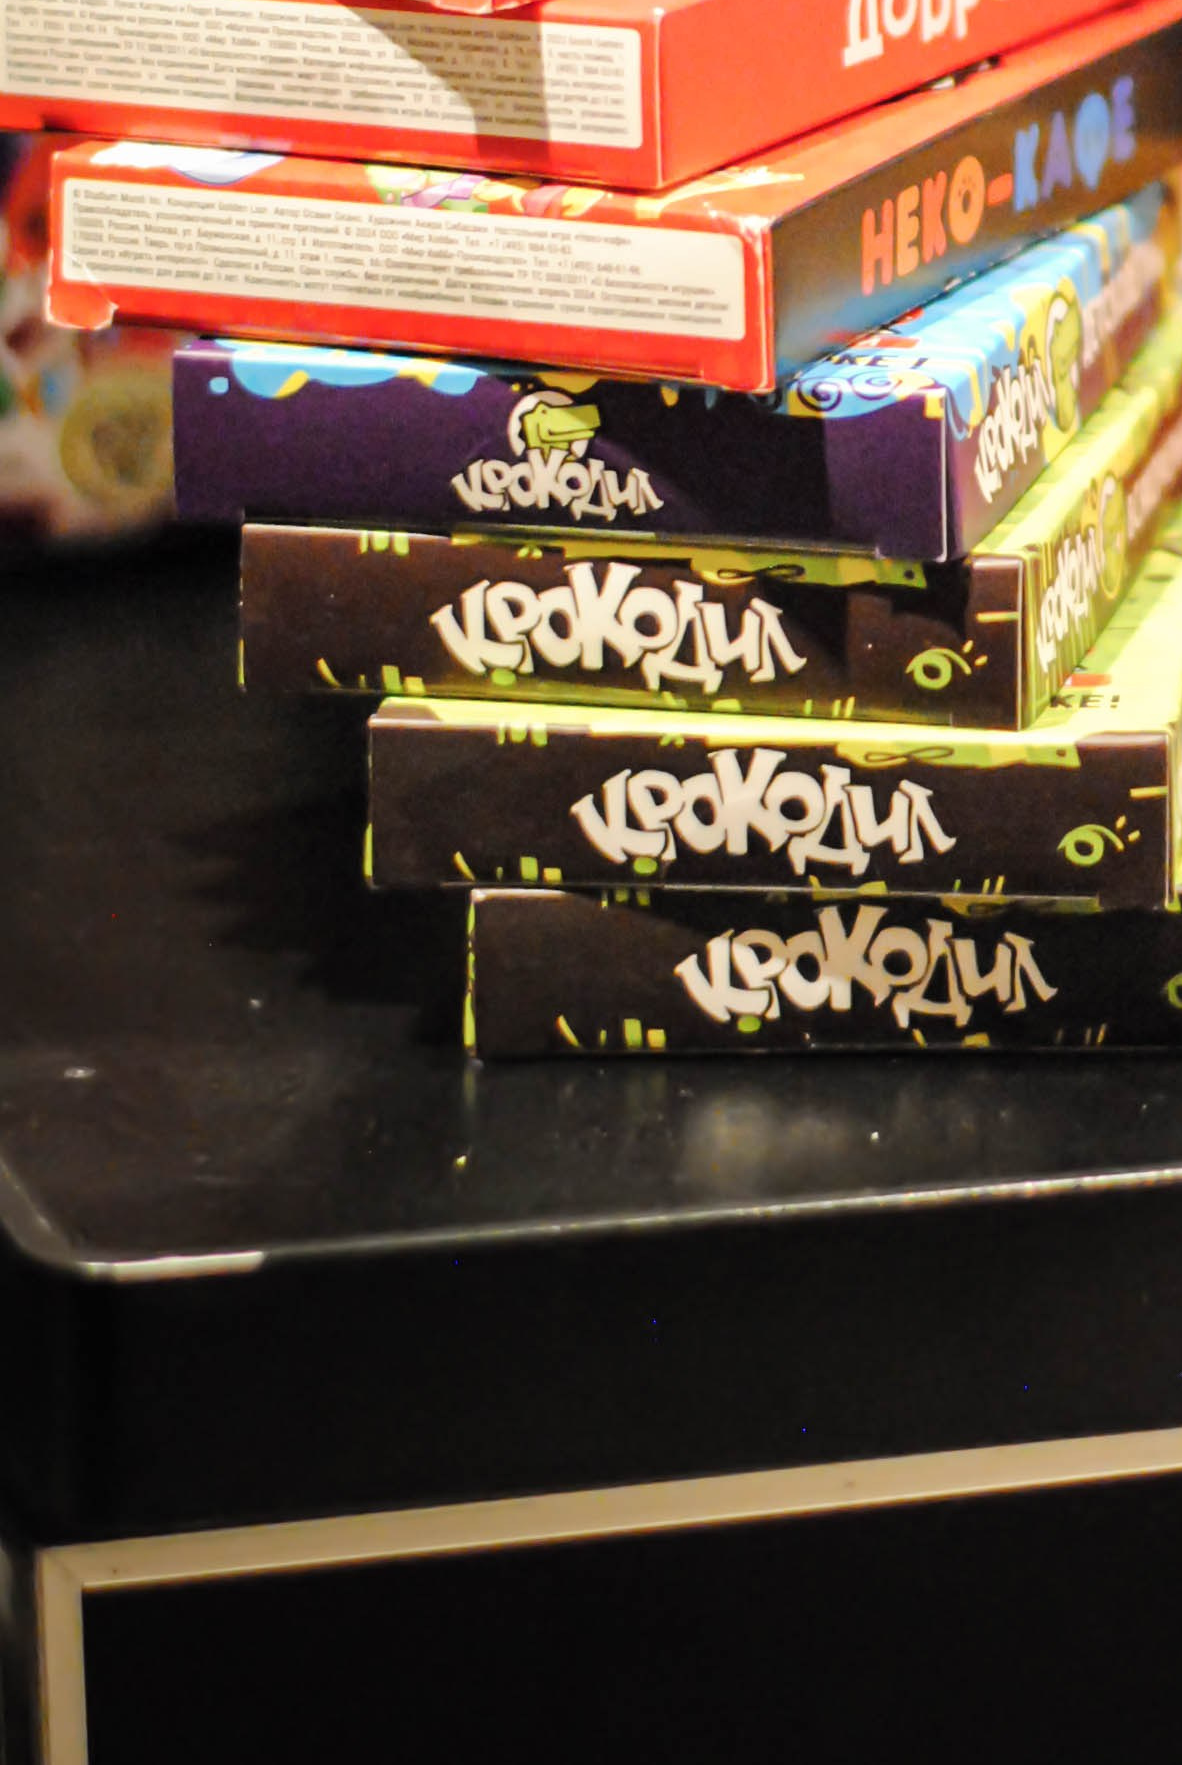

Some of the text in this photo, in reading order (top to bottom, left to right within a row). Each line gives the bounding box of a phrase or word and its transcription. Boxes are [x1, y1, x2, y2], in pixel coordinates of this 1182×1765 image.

[451, 449, 664, 522] КРОКОДИЛ
[430, 561, 808, 694] КРОКОДИЛ
[568, 747, 957, 875] КРОКОДИЛ
[674, 904, 1059, 1029] КРОКОДИЛ
